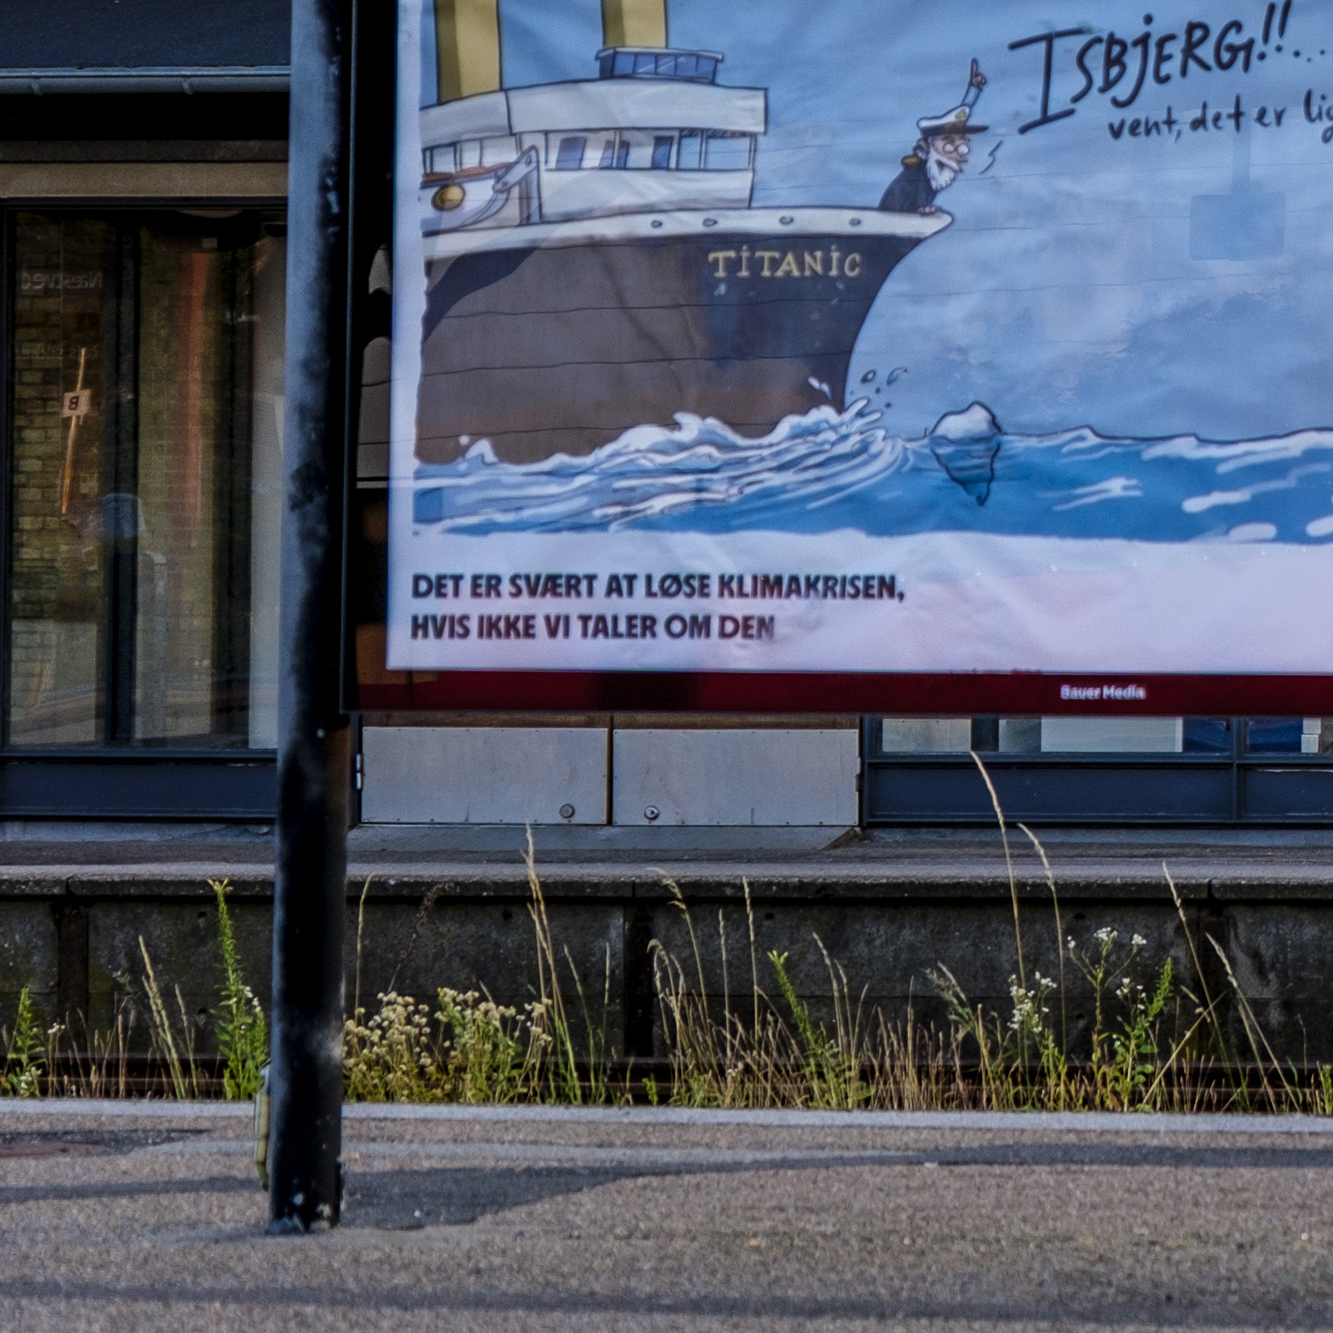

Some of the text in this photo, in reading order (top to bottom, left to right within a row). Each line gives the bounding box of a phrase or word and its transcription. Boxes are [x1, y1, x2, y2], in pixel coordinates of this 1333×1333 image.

[1188, 94, 1246, 133] det
[1253, 107, 1286, 127] er
[411, 571, 906, 602] DET ER SVÆRT AT LØSE KLIMAKRISEN,
[410, 612, 777, 640] HVIS IKKE VI TALER OM DEN
[1060, 684, 1146, 700] Bauer Media
